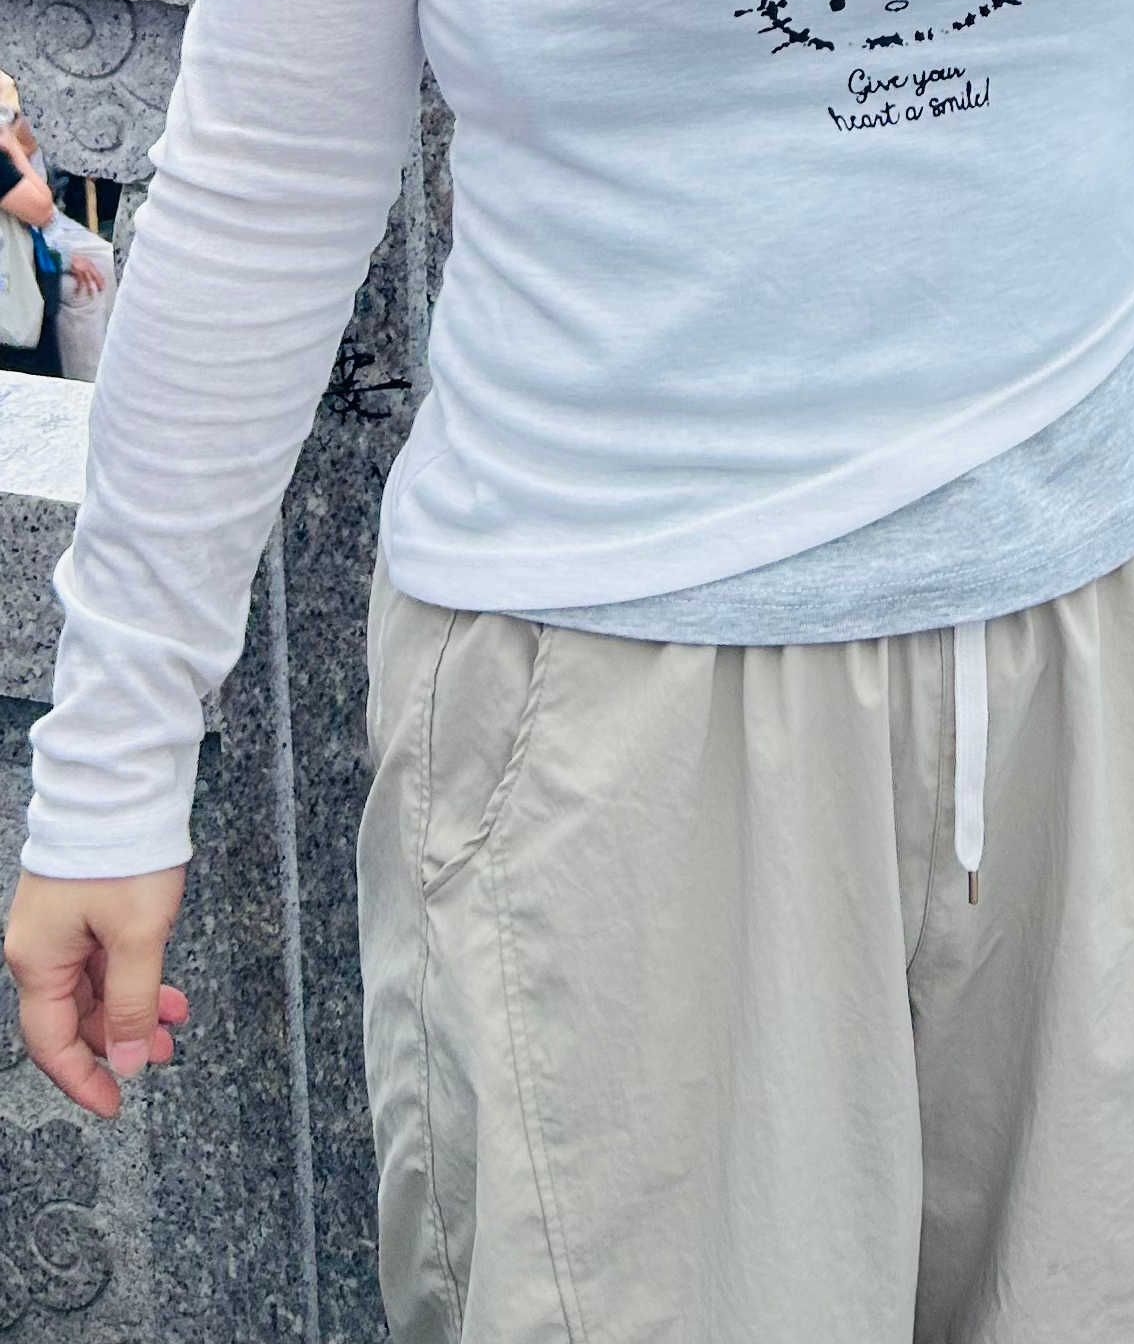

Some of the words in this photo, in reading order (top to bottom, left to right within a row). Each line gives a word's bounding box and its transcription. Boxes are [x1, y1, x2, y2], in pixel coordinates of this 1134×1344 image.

[828, 106, 900, 132] heart
[905, 105, 924, 123] a
[930, 77, 991, 117] smile!
[848, 69, 908, 104] Give
[911, 63, 967, 95] your
